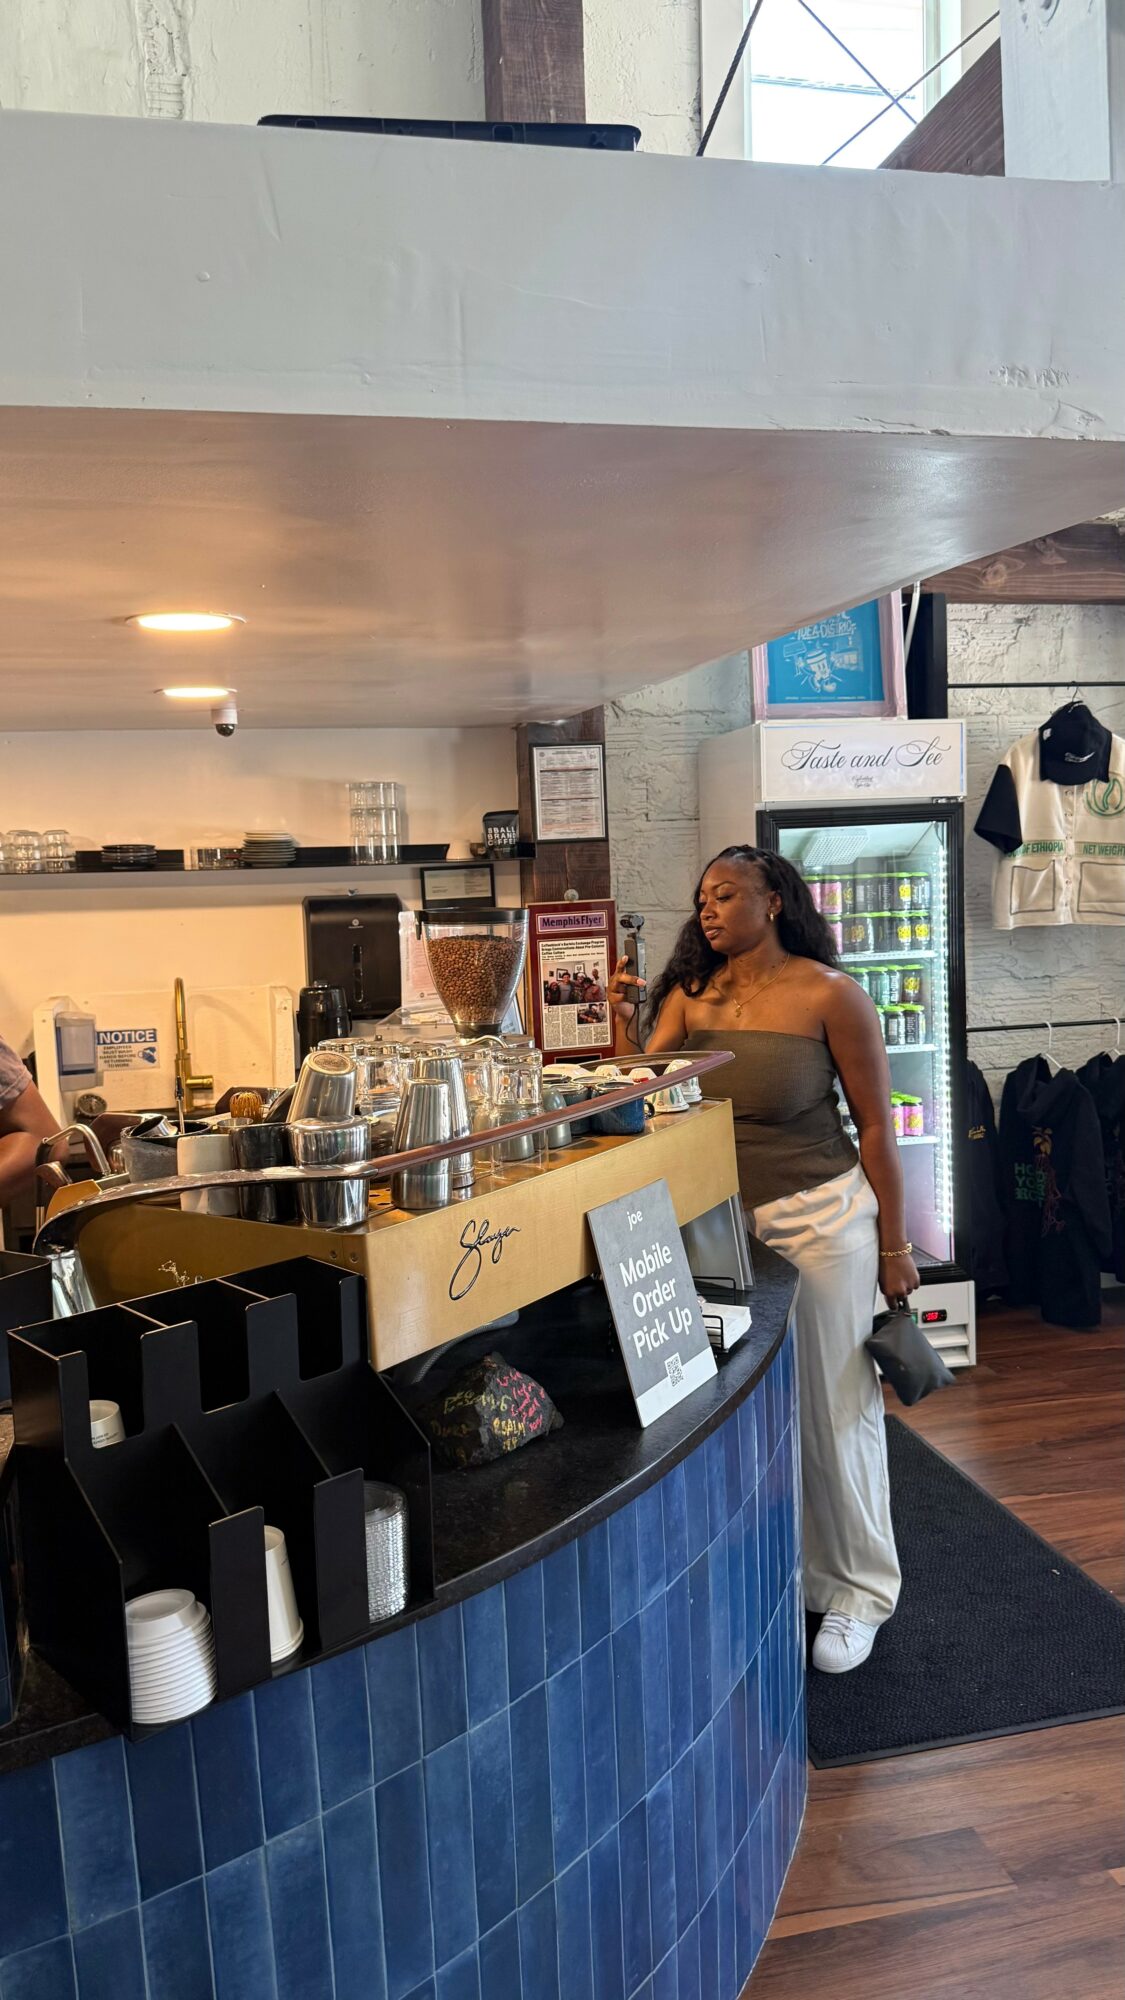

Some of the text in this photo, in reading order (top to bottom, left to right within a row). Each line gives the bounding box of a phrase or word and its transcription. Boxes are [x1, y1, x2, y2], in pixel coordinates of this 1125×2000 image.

[781, 736, 952, 771] Taste and See
[1032, 841, 1064, 853] ETHIOPIA
[1083, 844, 1096, 855] NET
[99, 1030, 155, 1044] NOTICE
[626, 1208, 644, 1231] joe
[618, 1242, 673, 1288] Mobile
[632, 1277, 677, 1319] Order
[632, 1306, 693, 1359] Pick Up
